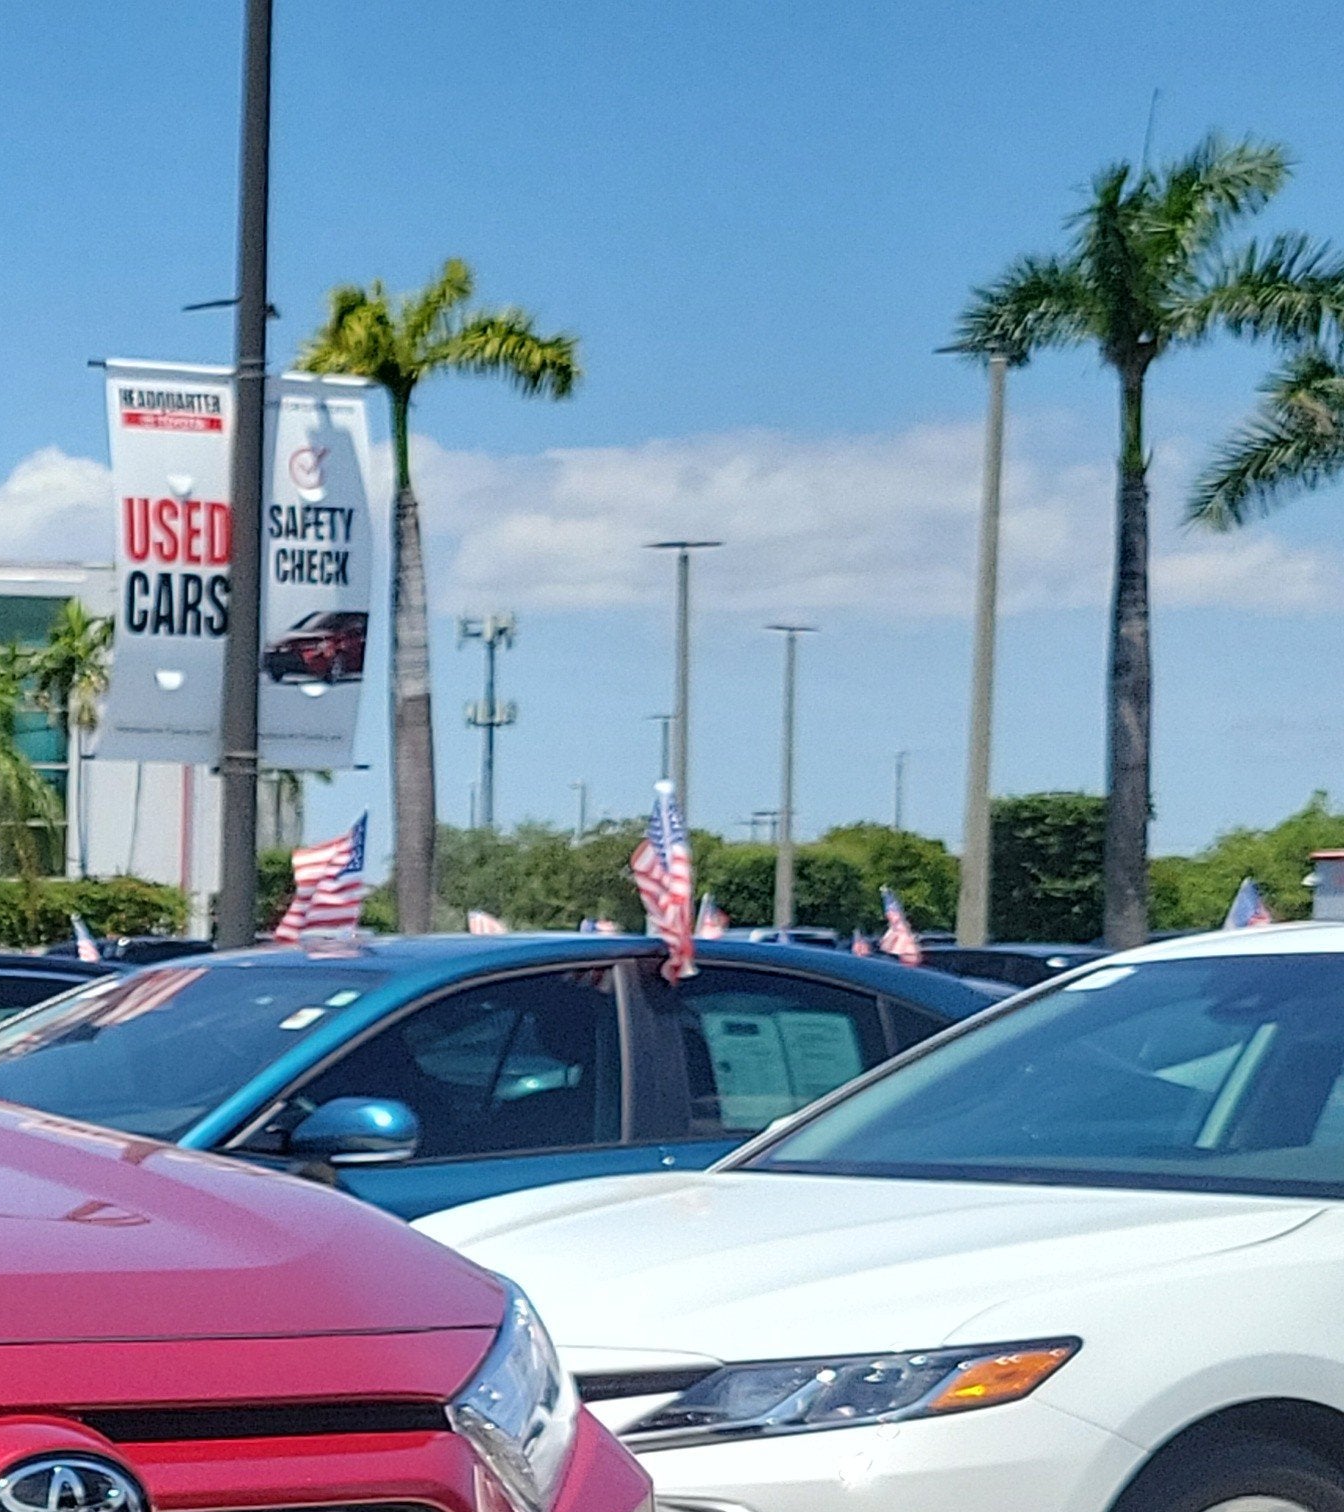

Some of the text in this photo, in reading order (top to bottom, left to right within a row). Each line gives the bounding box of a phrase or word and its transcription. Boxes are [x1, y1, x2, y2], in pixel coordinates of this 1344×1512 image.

[124, 497, 231, 566] USED
[269, 504, 353, 543] SAFETY
[276, 549, 349, 585] CHECK
[125, 571, 230, 636] CARS
